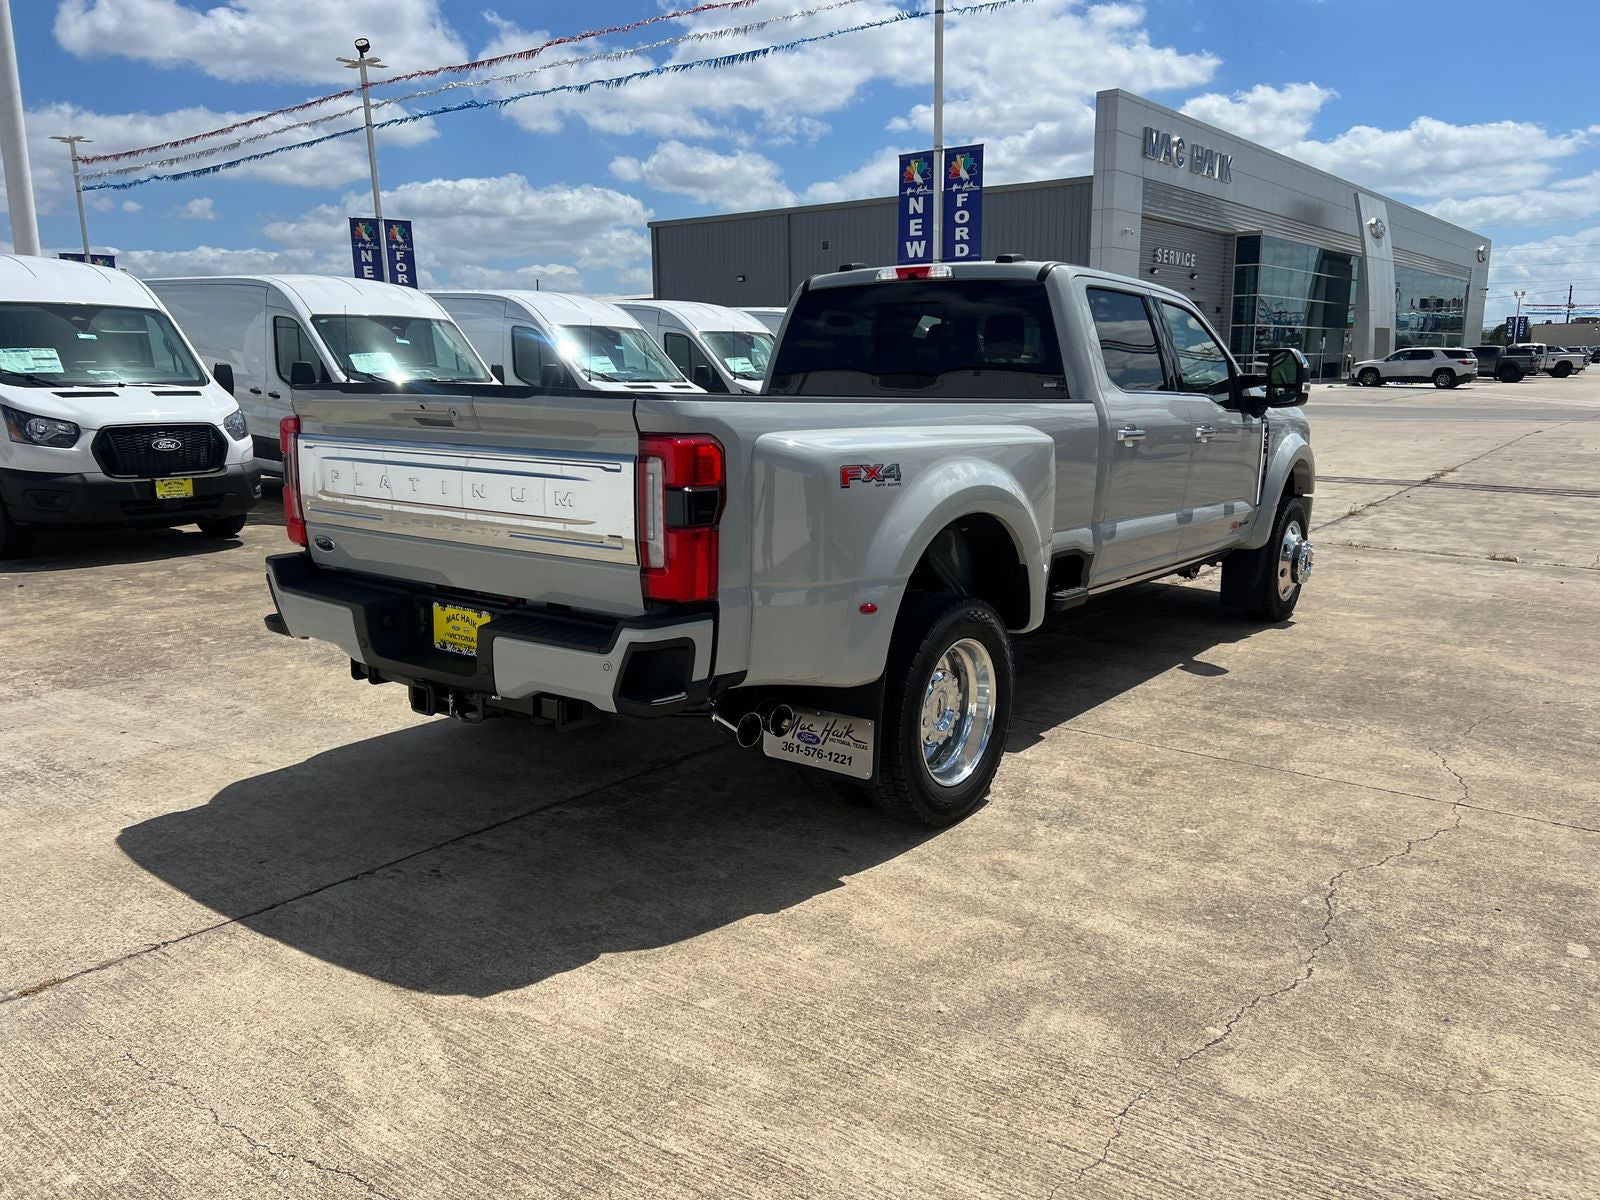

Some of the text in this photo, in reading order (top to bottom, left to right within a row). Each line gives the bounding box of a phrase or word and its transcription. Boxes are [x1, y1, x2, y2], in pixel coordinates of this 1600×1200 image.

[1142, 126, 1233, 184] MAC HAIK
[905, 196, 926, 258] NEW
[954, 193, 970, 257] FORD
[361, 250, 375, 278] NE
[395, 251, 409, 283] FOR
[1155, 248, 1196, 267] SERVICE
[331, 469, 574, 508] PLATINUM
[840, 464, 901, 488] FX4
[446, 613, 477, 630] MAC HAIK
[790, 714, 868, 745] Mac Haik
[799, 733, 818, 744] Ford
[781, 741, 853, 767] 361-576-1221
[852, 743, 868, 751] TEXAS
